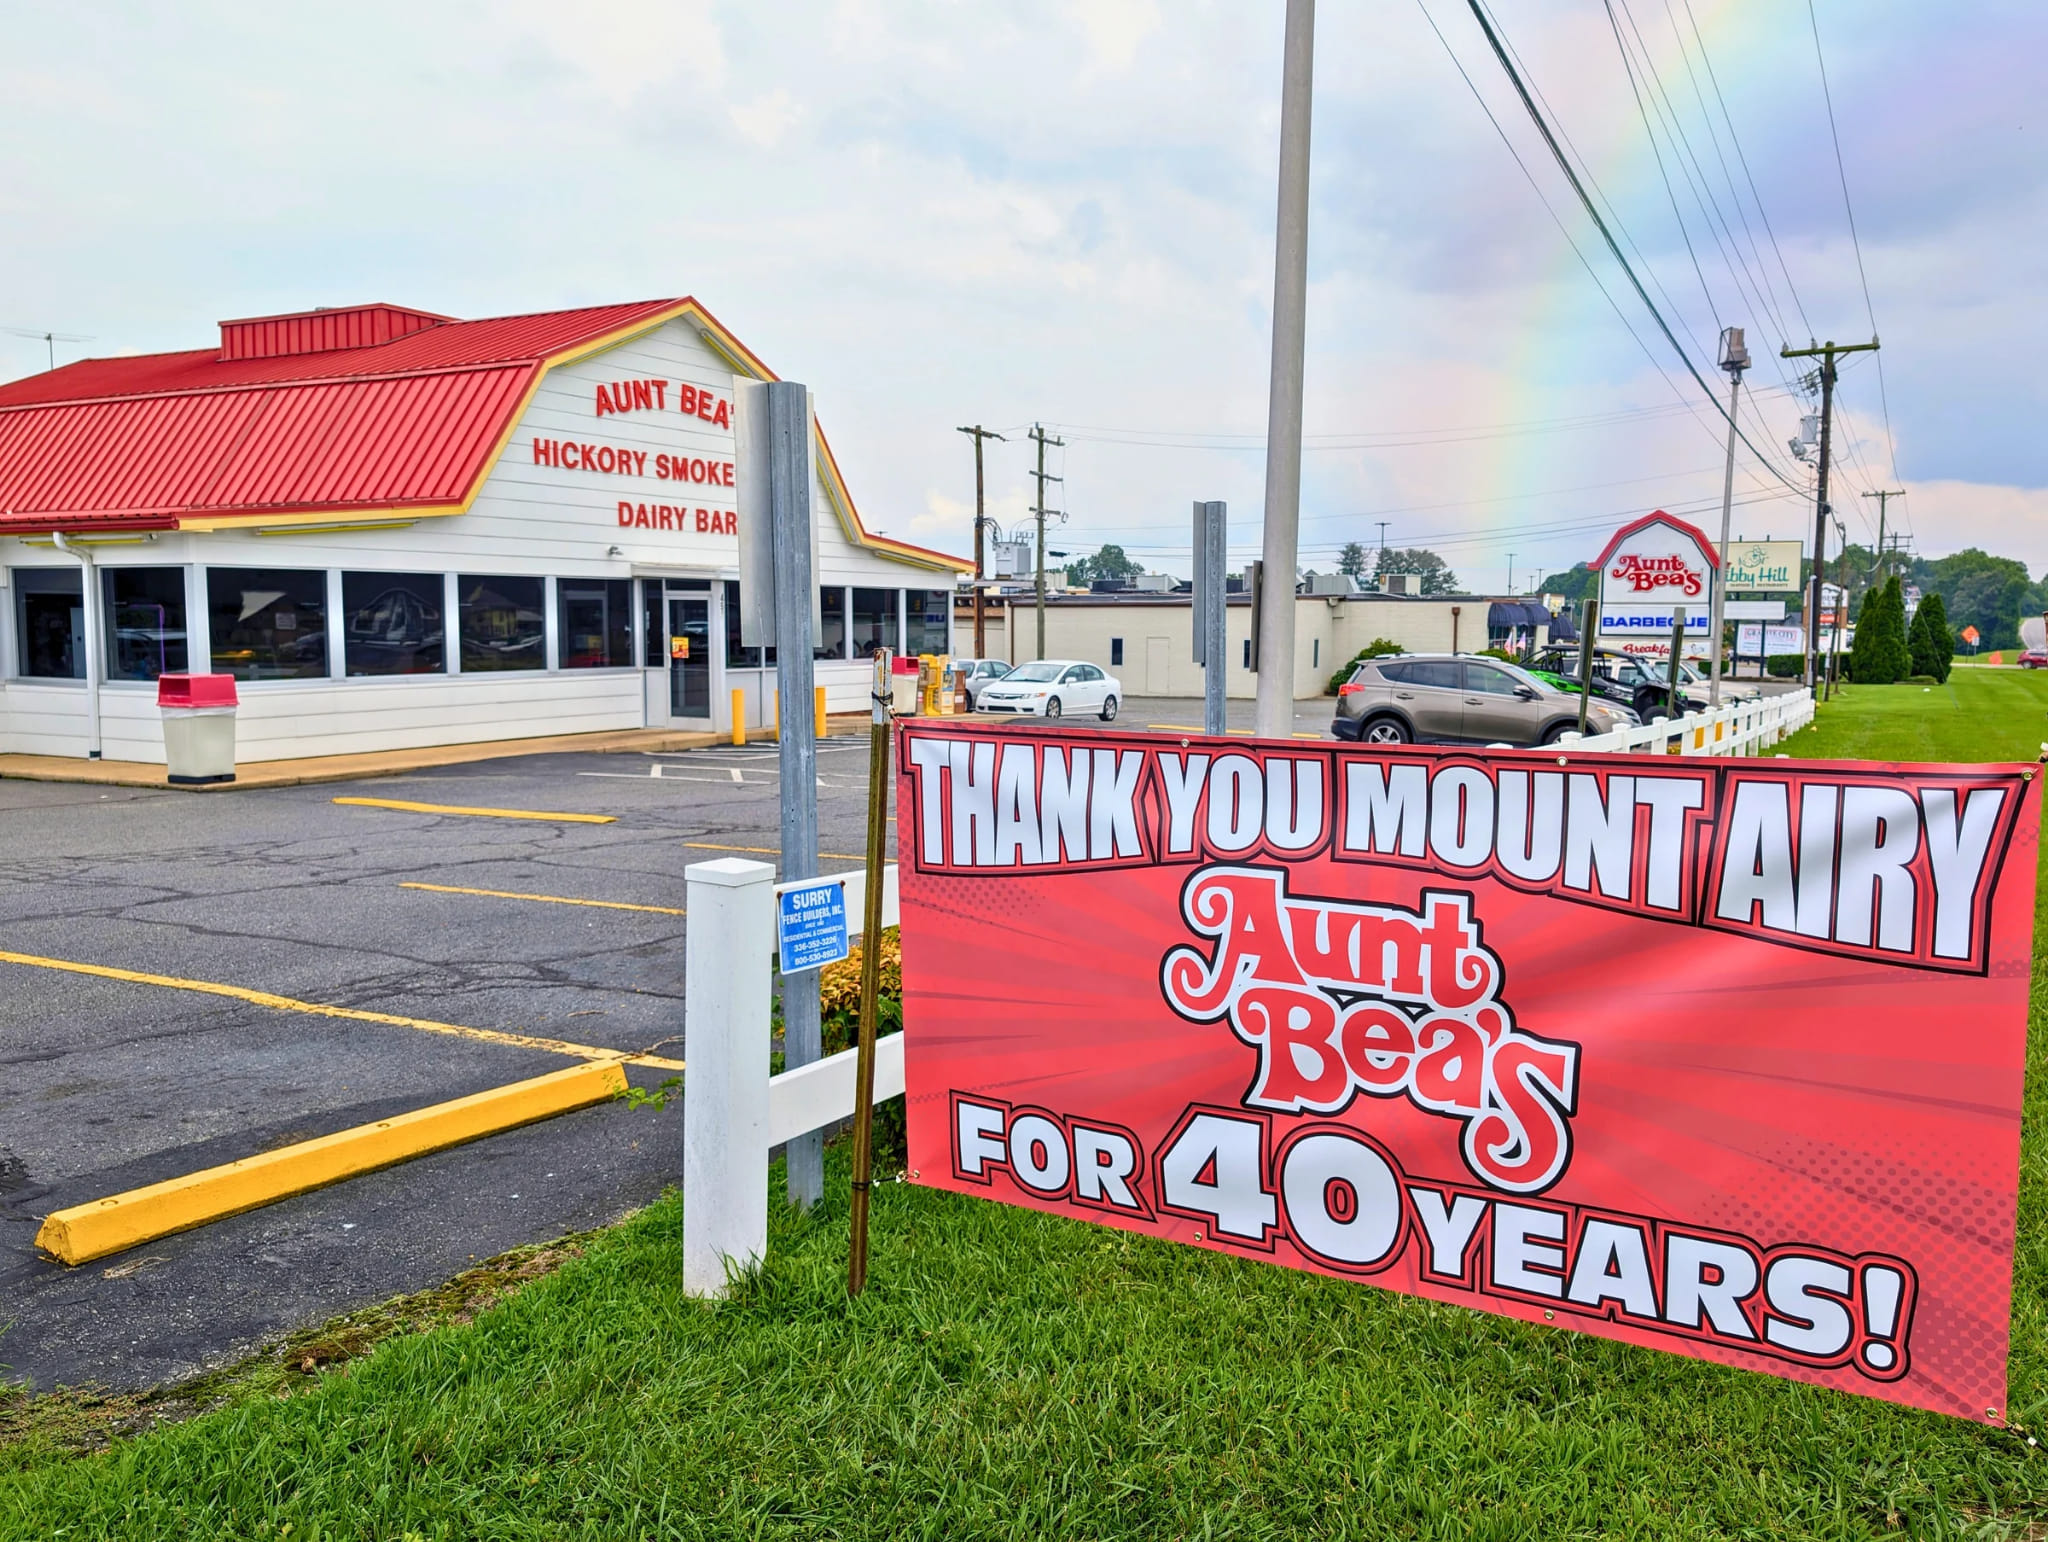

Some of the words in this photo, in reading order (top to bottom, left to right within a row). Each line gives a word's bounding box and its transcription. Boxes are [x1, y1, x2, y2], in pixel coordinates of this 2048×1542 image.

[595, 379, 669, 417] AUNT
[679, 384, 735, 430] BEA'
[533, 438, 648, 477] HICKORY
[617, 501, 687, 531] DAIRY
[695, 508, 738, 536] BAR
[1612, 554, 1685, 578] Aunt
[1724, 566, 1755, 588] ibby
[1758, 566, 1790, 582] Hill
[910, 737, 1146, 867] THANK
[1157, 750, 1323, 853] YOU
[1344, 761, 1704, 912] MOUNT
[1717, 780, 2005, 960] AIRY
[783, 913, 802, 925] FENCE
[832, 905, 843, 915] INC.
[792, 888, 832, 910] SURRY
[1168, 872, 1495, 1013] Aunt
[957, 1100, 1137, 1208] FOR
[1162, 1111, 1399, 1263] 40
[1406, 1186, 1902, 1368] YEARS!
